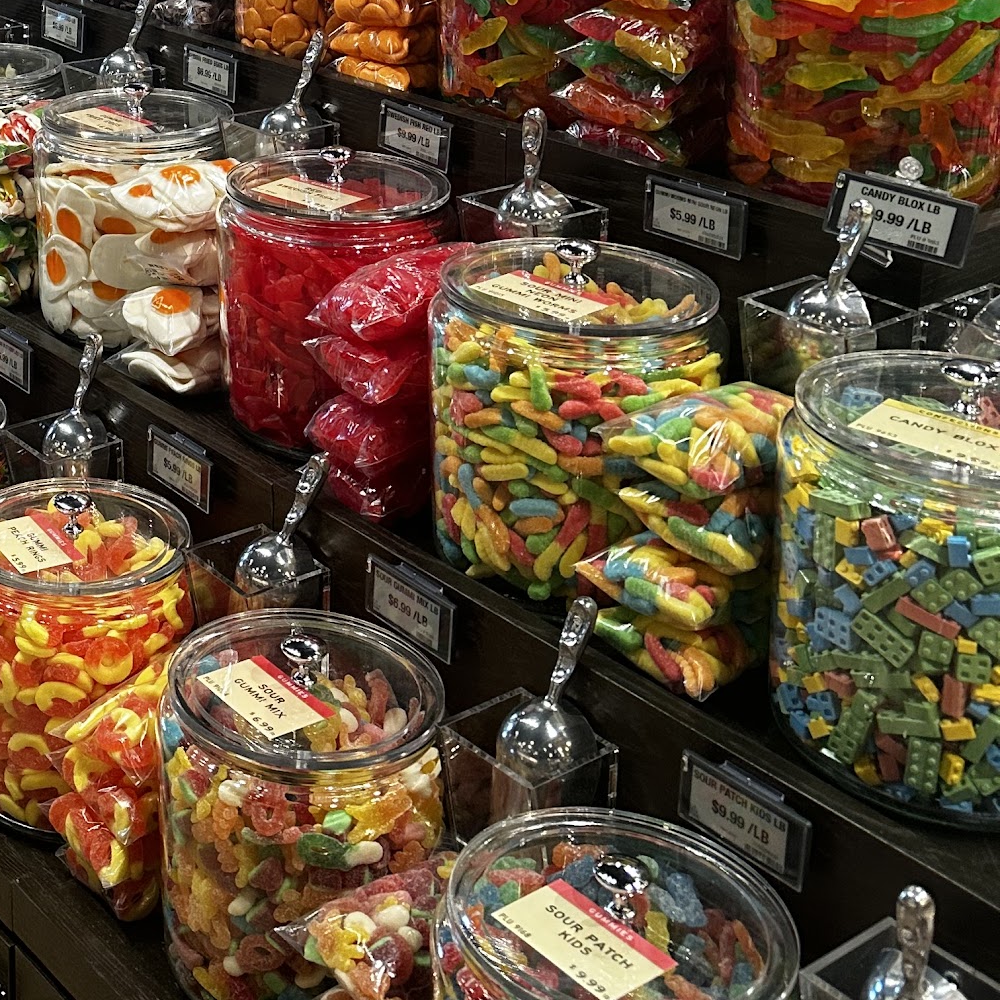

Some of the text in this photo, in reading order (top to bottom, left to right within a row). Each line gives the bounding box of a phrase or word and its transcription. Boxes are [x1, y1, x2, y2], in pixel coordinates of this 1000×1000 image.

[387, 110, 409, 125] SWEDISH
[410, 119, 421, 128] FISH
[422, 124, 432, 133] RED
[398, 128, 430, 147] $9.99 /LB
[861, 186, 941, 215] CANDY BLOX LB
[669, 208, 716, 230] $5.99 /LB
[874, 209, 932, 235] 9.99 /LB
[491, 284, 532, 298] GUMMI
[533, 298, 578, 313] WORMS
[520, 281, 583, 304] SOUR MINI
[525, 289, 559, 302] NEON
[889, 415, 999, 451] CANDY BLOX
[8, 526, 27, 545] PEACH
[27, 546, 46, 563] RINGS
[27, 532, 49, 552] GUMMI
[388, 594, 428, 628] $6.99 /LB
[393, 581, 415, 601] GUMMI
[416, 594, 428, 610] MIX
[430, 605, 439, 615] LB
[234, 678, 267, 703] GUMMI
[265, 703, 287, 719] MIX
[258, 684, 286, 704] SOUR
[277, 675, 309, 699] GUMMIES
[250, 712, 274, 732] $6.99
[694, 769, 786, 832] SOUR PATCH KIDS LB
[711, 800, 769, 844] $9.99 /LB
[499, 913, 512, 925] PLU
[588, 907, 634, 941] GUMMIES
[545, 904, 634, 970] SOUR PATCH
[558, 930, 592, 956] KIDS
